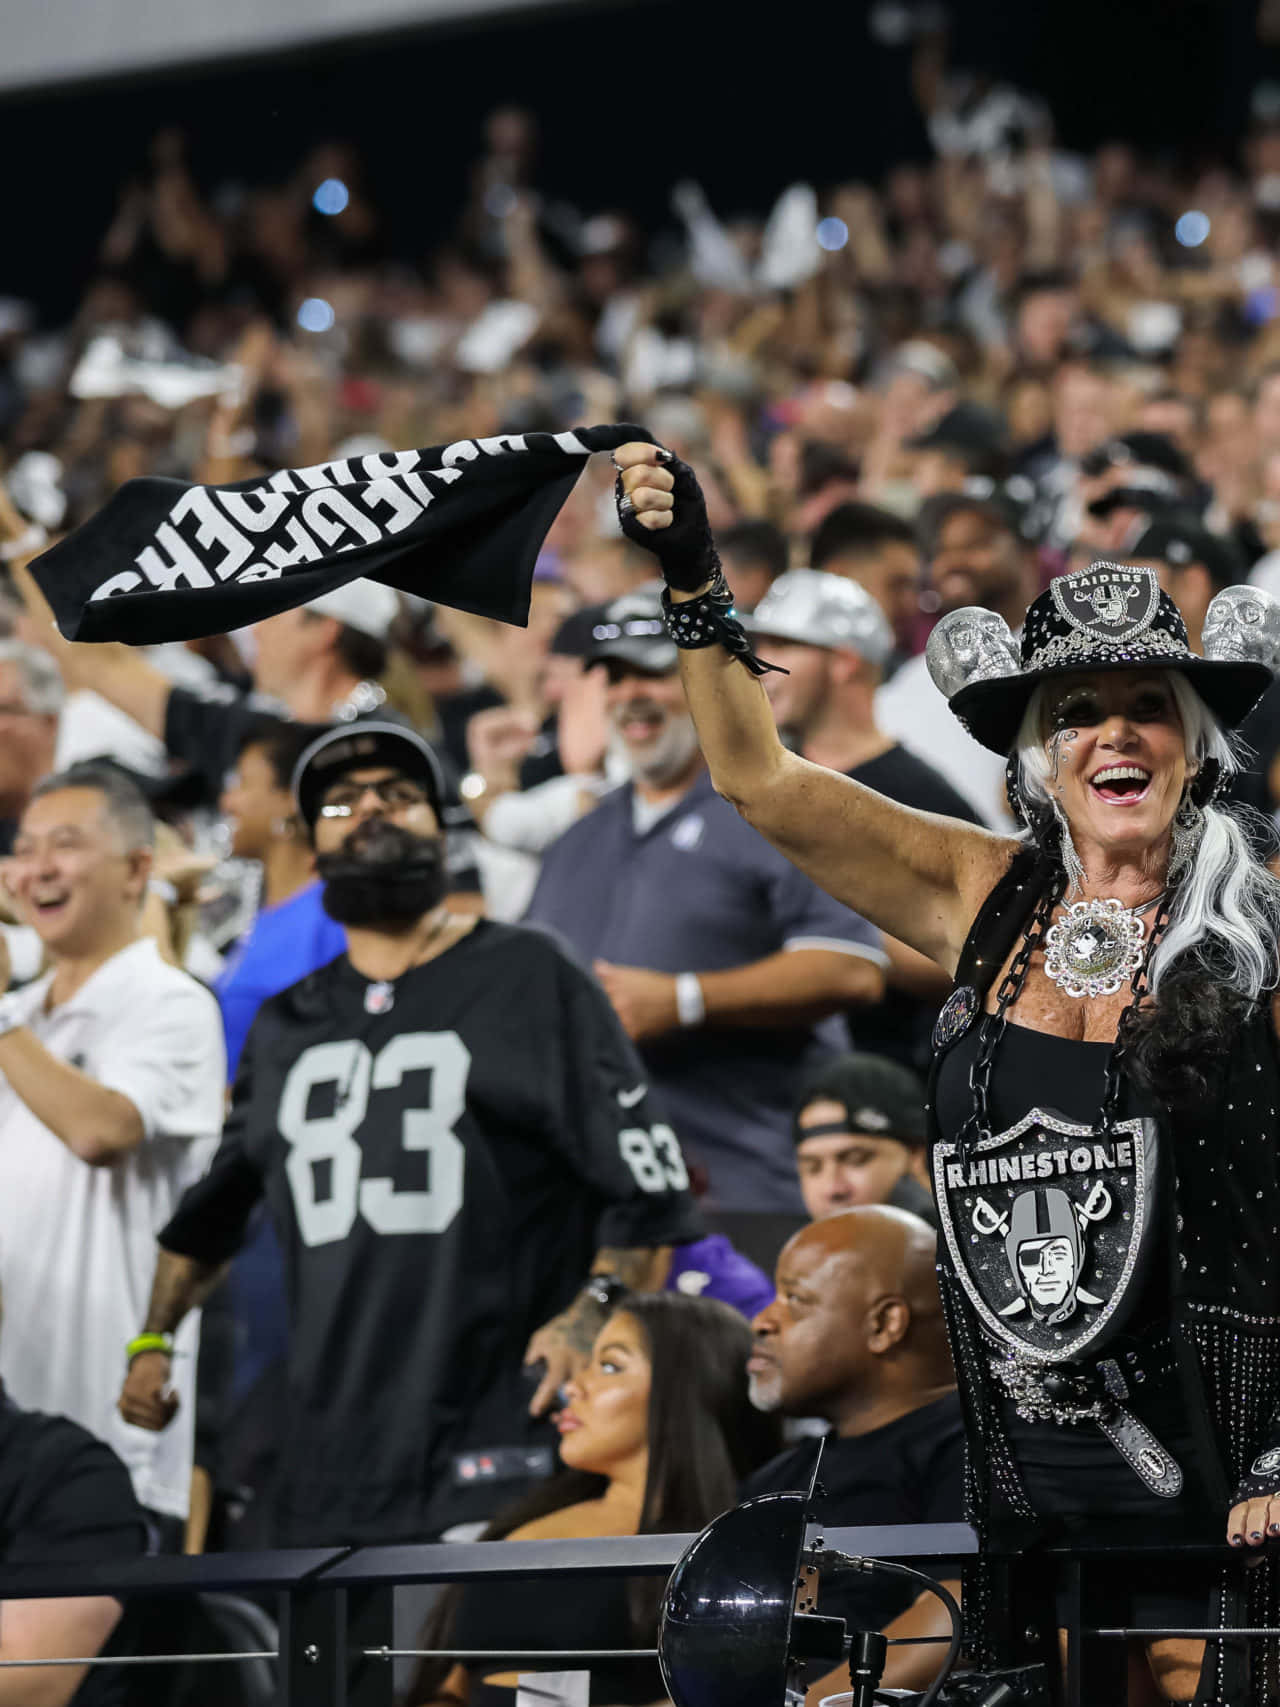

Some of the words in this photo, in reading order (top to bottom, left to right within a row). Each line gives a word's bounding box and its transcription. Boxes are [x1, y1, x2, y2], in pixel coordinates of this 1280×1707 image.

[1068, 573, 1142, 590] RAIDERS
[277, 1030, 473, 1247] 83
[617, 1122, 690, 1193] 83
[945, 1140, 1133, 1190] RHINESTONE
